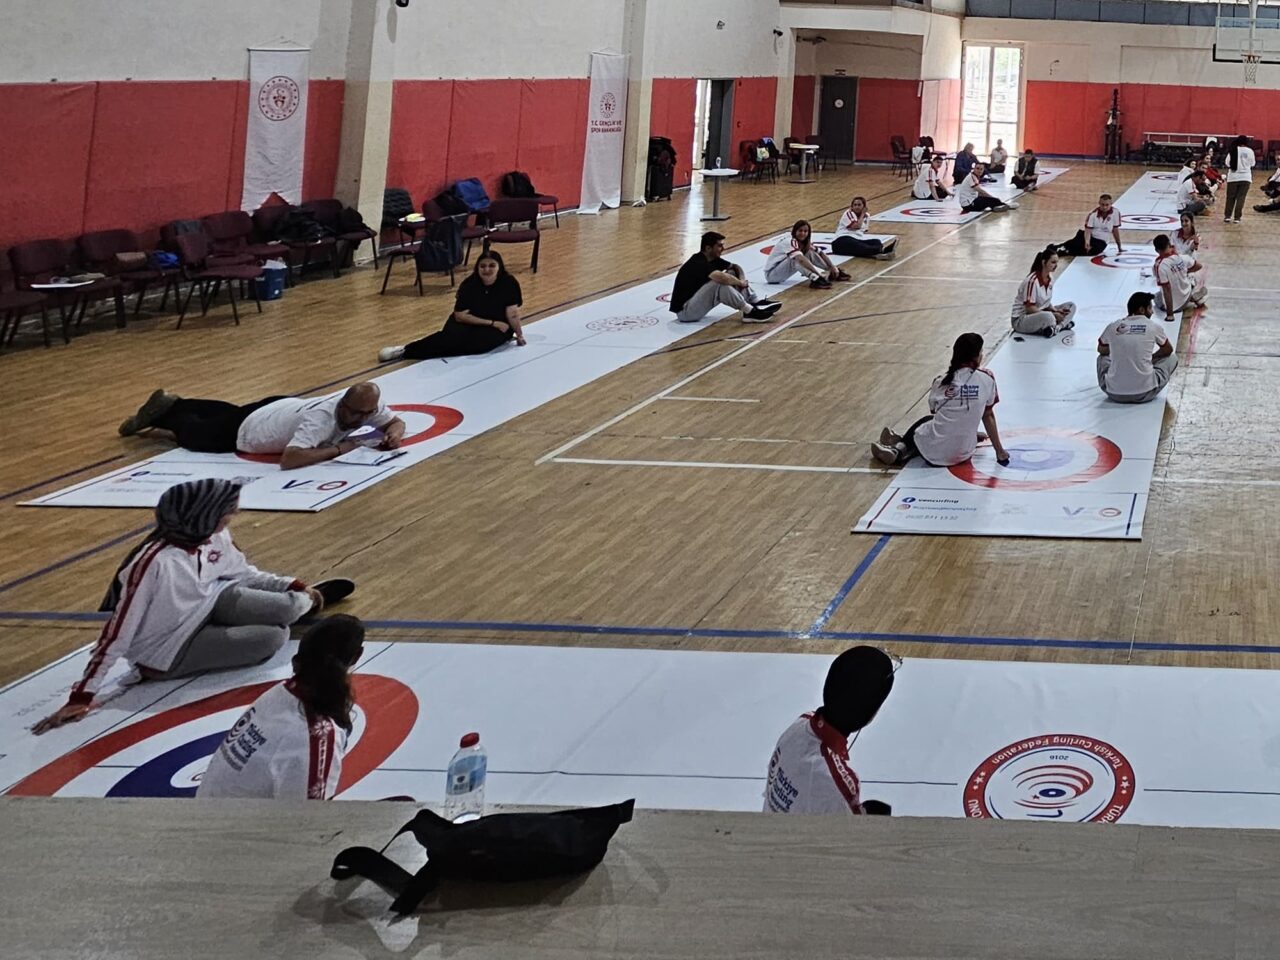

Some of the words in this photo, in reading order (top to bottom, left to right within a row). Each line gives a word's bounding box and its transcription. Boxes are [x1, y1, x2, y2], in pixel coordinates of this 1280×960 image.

[992, 738, 1049, 764] Federation
[1053, 736, 1092, 748] Curling
[1094, 744, 1123, 770] Turkish
